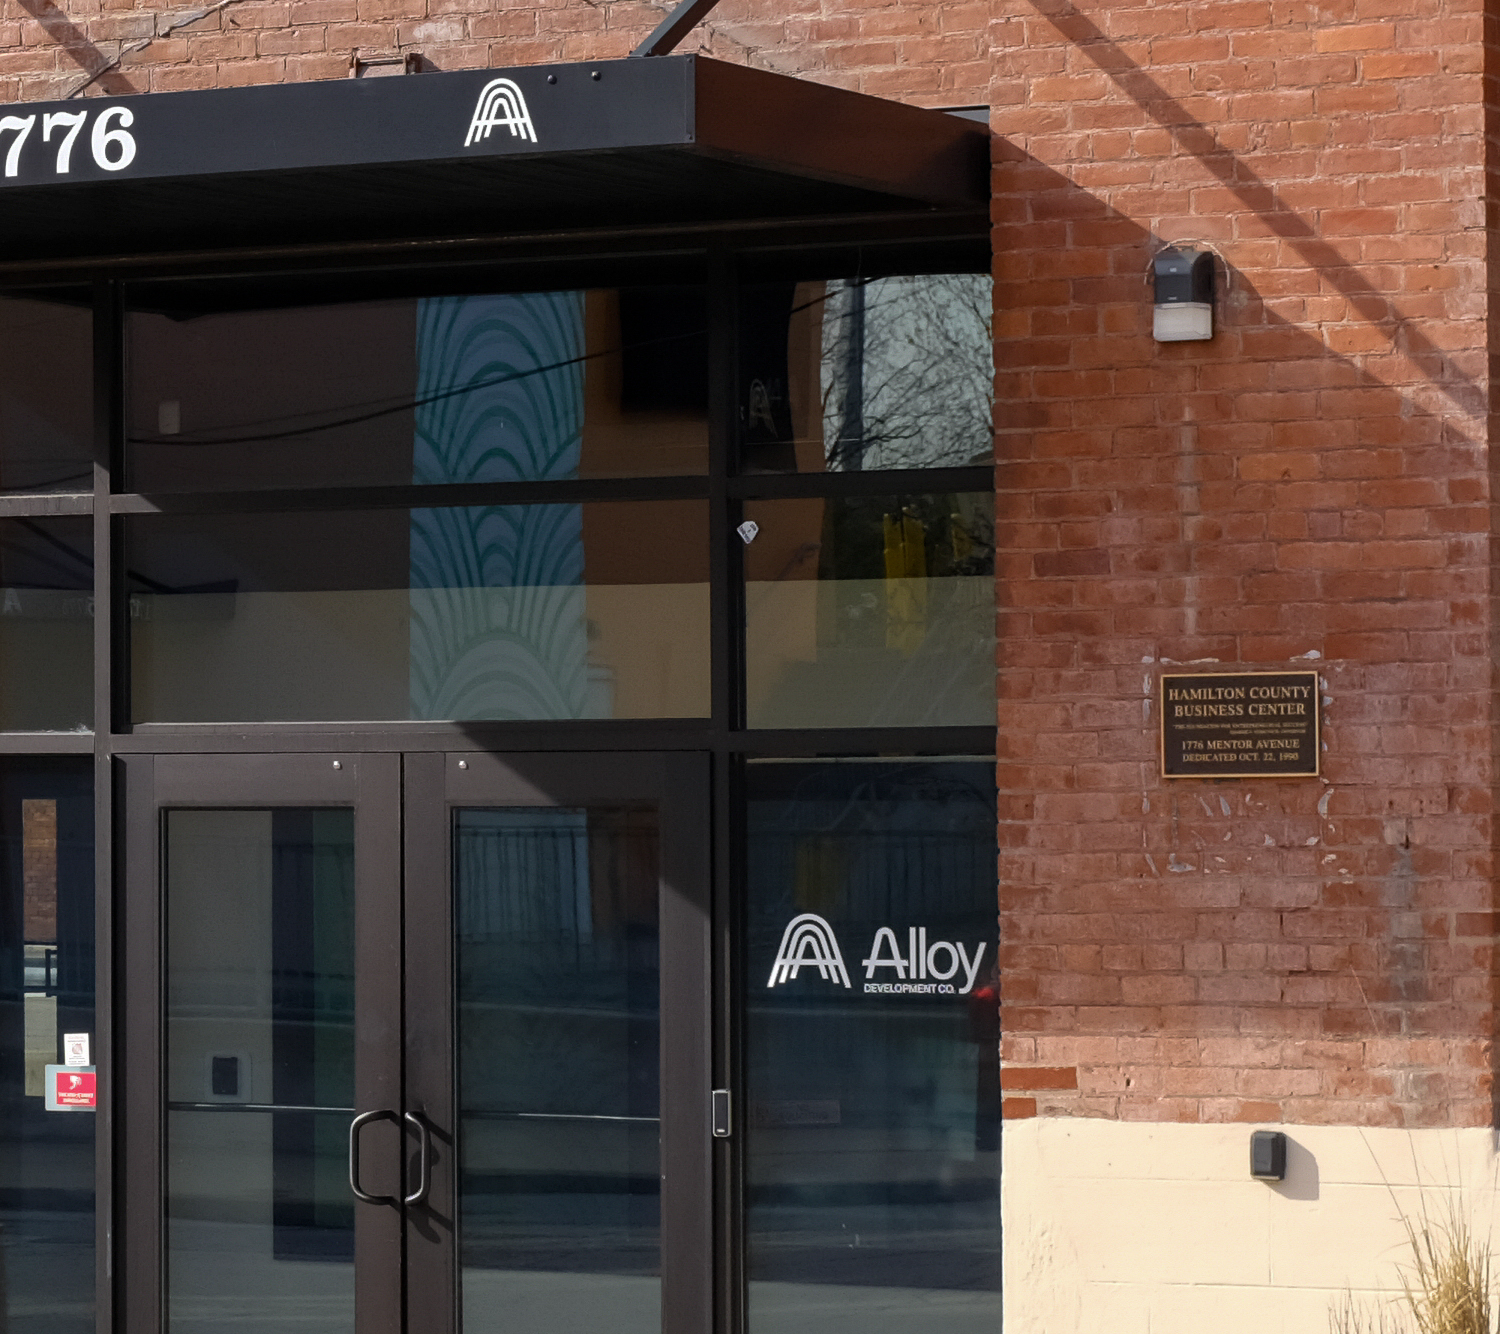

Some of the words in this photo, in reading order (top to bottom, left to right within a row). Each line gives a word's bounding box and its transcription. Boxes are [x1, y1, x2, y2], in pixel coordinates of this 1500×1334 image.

[1168, 687, 1246, 701] HAMILTON
[1249, 686, 1311, 699] COUNTY
[1174, 704, 1244, 717] BUSINESS
[1248, 703, 1306, 716] CENTER
[1182, 740, 1204, 751] 1776
[1207, 740, 1253, 750] MENTOR
[1255, 738, 1300, 749] AVENUE
[1182, 753, 1237, 763] DEDICATED
[861, 926, 987, 995] Alloy
[863, 983, 937, 994] DEVELOPMENT
